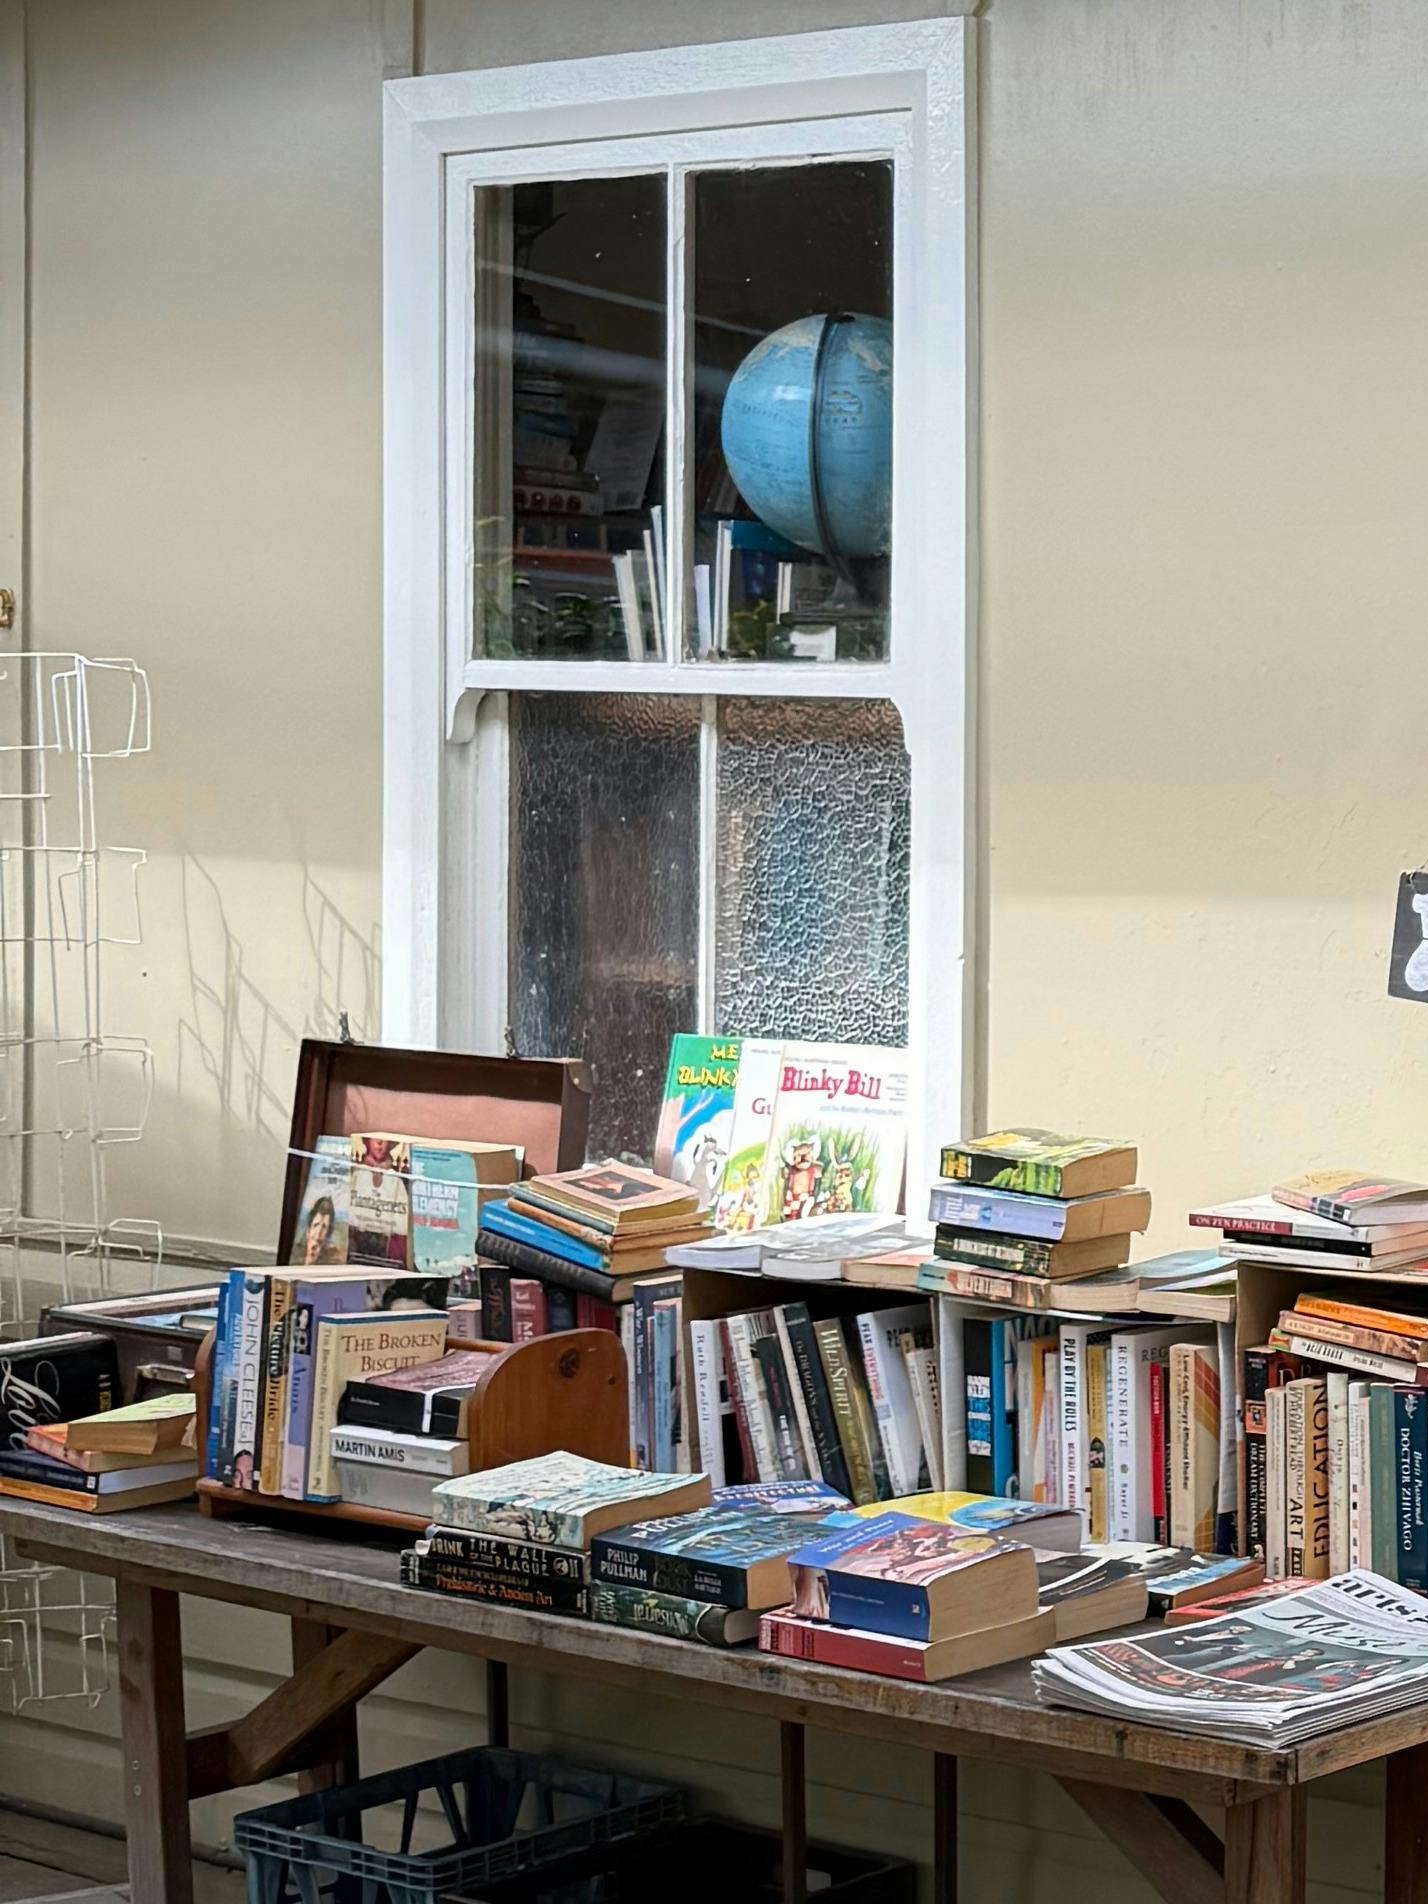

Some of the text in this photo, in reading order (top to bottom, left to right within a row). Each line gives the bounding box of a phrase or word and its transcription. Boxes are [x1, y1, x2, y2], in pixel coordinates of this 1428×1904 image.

[780, 1066, 844, 1100] Blinky
[844, 1070, 882, 1100] Bill
[273, 1289, 285, 1315] The
[340, 1331, 443, 1353] THE BROKEN
[696, 1334, 706, 1367] Ruth
[1063, 1337, 1077, 1362] PLAY
[240, 1298, 259, 1432] JOHN CLEESE
[361, 1354, 421, 1373] BISCUIT
[1064, 1364, 1076, 1378] BY
[267, 1378, 280, 1420] Bride
[1064, 1380, 1077, 1398] THE
[1117, 1345, 1129, 1448] REGENERATE
[1064, 1400, 1078, 1432] RULES
[335, 1439, 405, 1463] MARTIN AMIS
[1312, 1384, 1328, 1559] EDUCATION
[1399, 1427, 1412, 1551] DOCTOR ZHIVAGO
[1290, 1497, 1304, 1540] ART
[470, 1538, 549, 1563] THE WALL
[607, 1548, 640, 1565] PHILIP
[495, 1555, 550, 1577] PLAGUE
[600, 1560, 648, 1582] PULLMAN
[1331, 1578, 1419, 1617] arts
